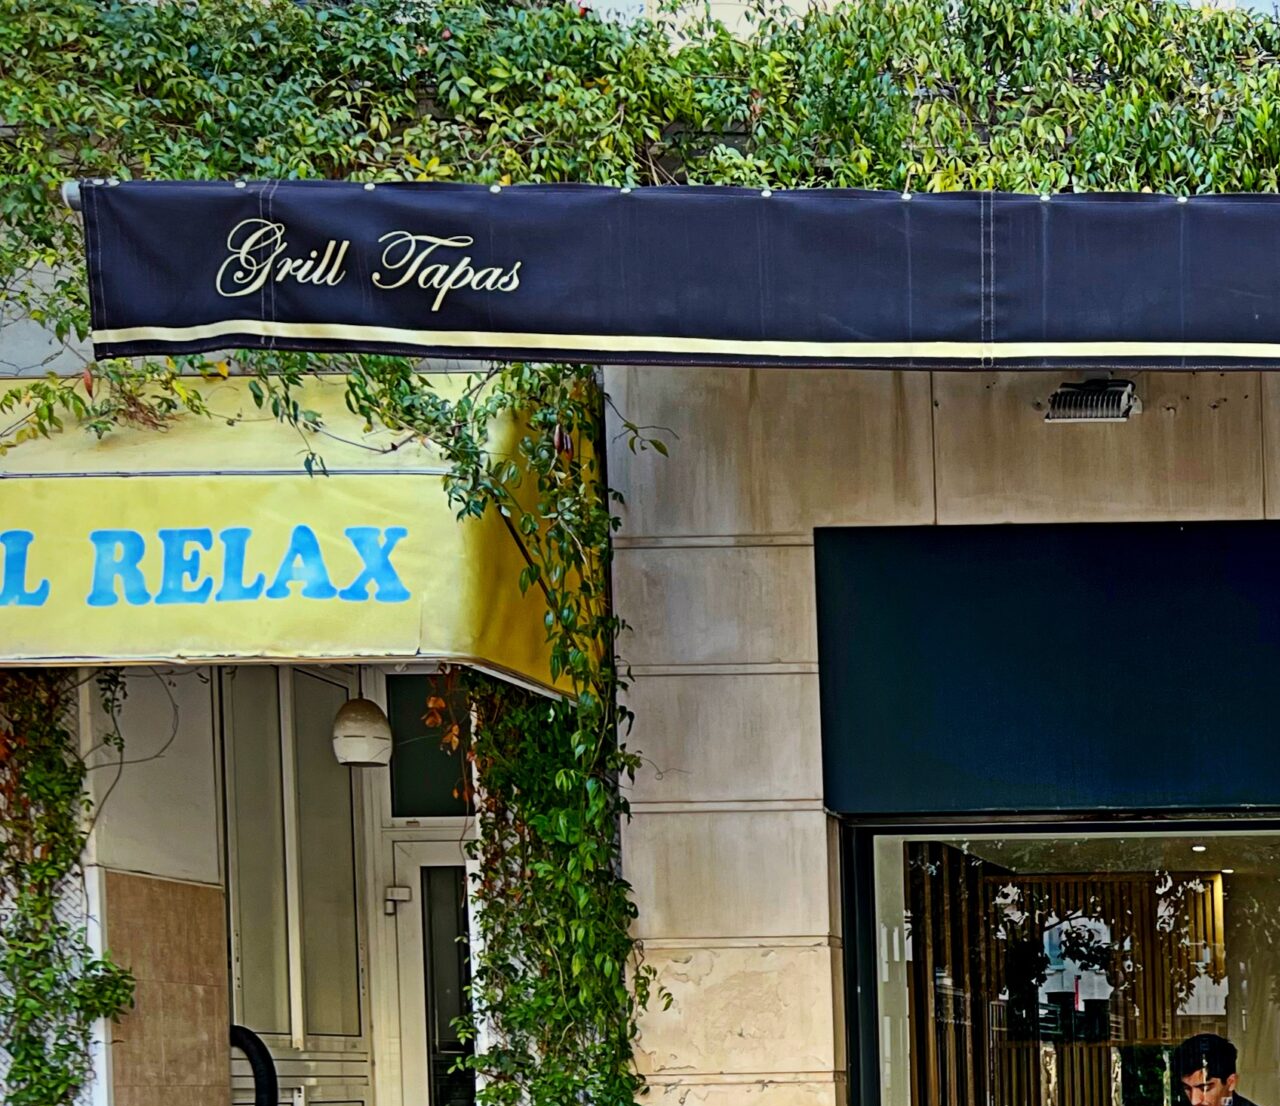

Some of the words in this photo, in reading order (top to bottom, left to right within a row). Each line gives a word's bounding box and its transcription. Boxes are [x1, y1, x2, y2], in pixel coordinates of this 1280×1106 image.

[216, 218, 349, 296] Grill
[372, 230, 522, 311] Tapas
[86, 524, 411, 607] RELAX
